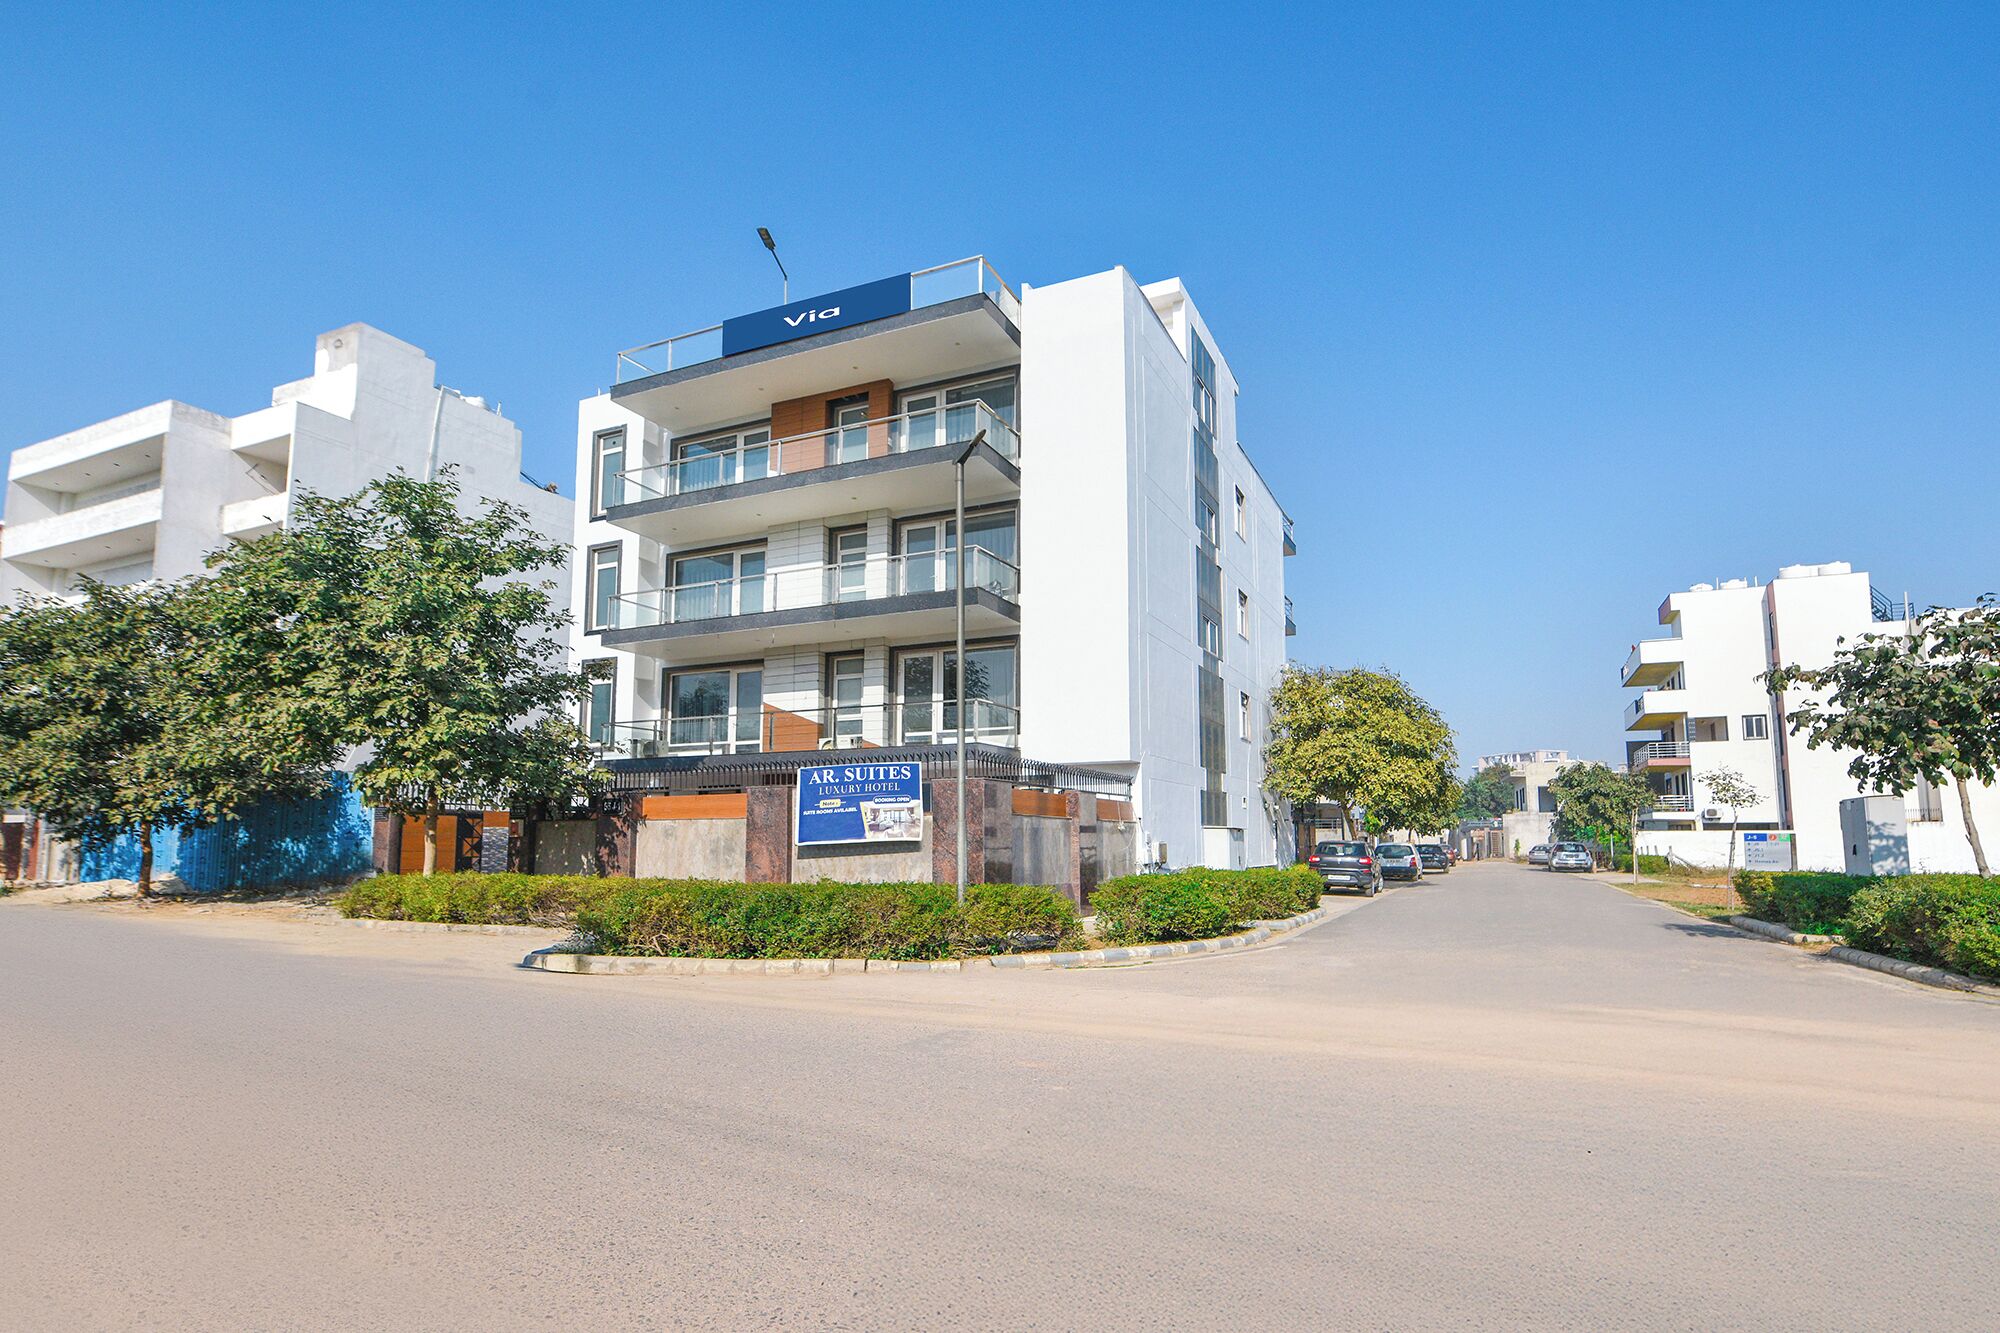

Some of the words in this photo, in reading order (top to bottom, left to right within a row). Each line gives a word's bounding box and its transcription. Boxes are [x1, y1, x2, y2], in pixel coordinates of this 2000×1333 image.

[783, 306, 840, 327] Via
[808, 769, 839, 785] AR.
[844, 765, 911, 782] SUITES
[818, 783, 862, 796] LUXURY
[864, 782, 901, 792] HOTEL
